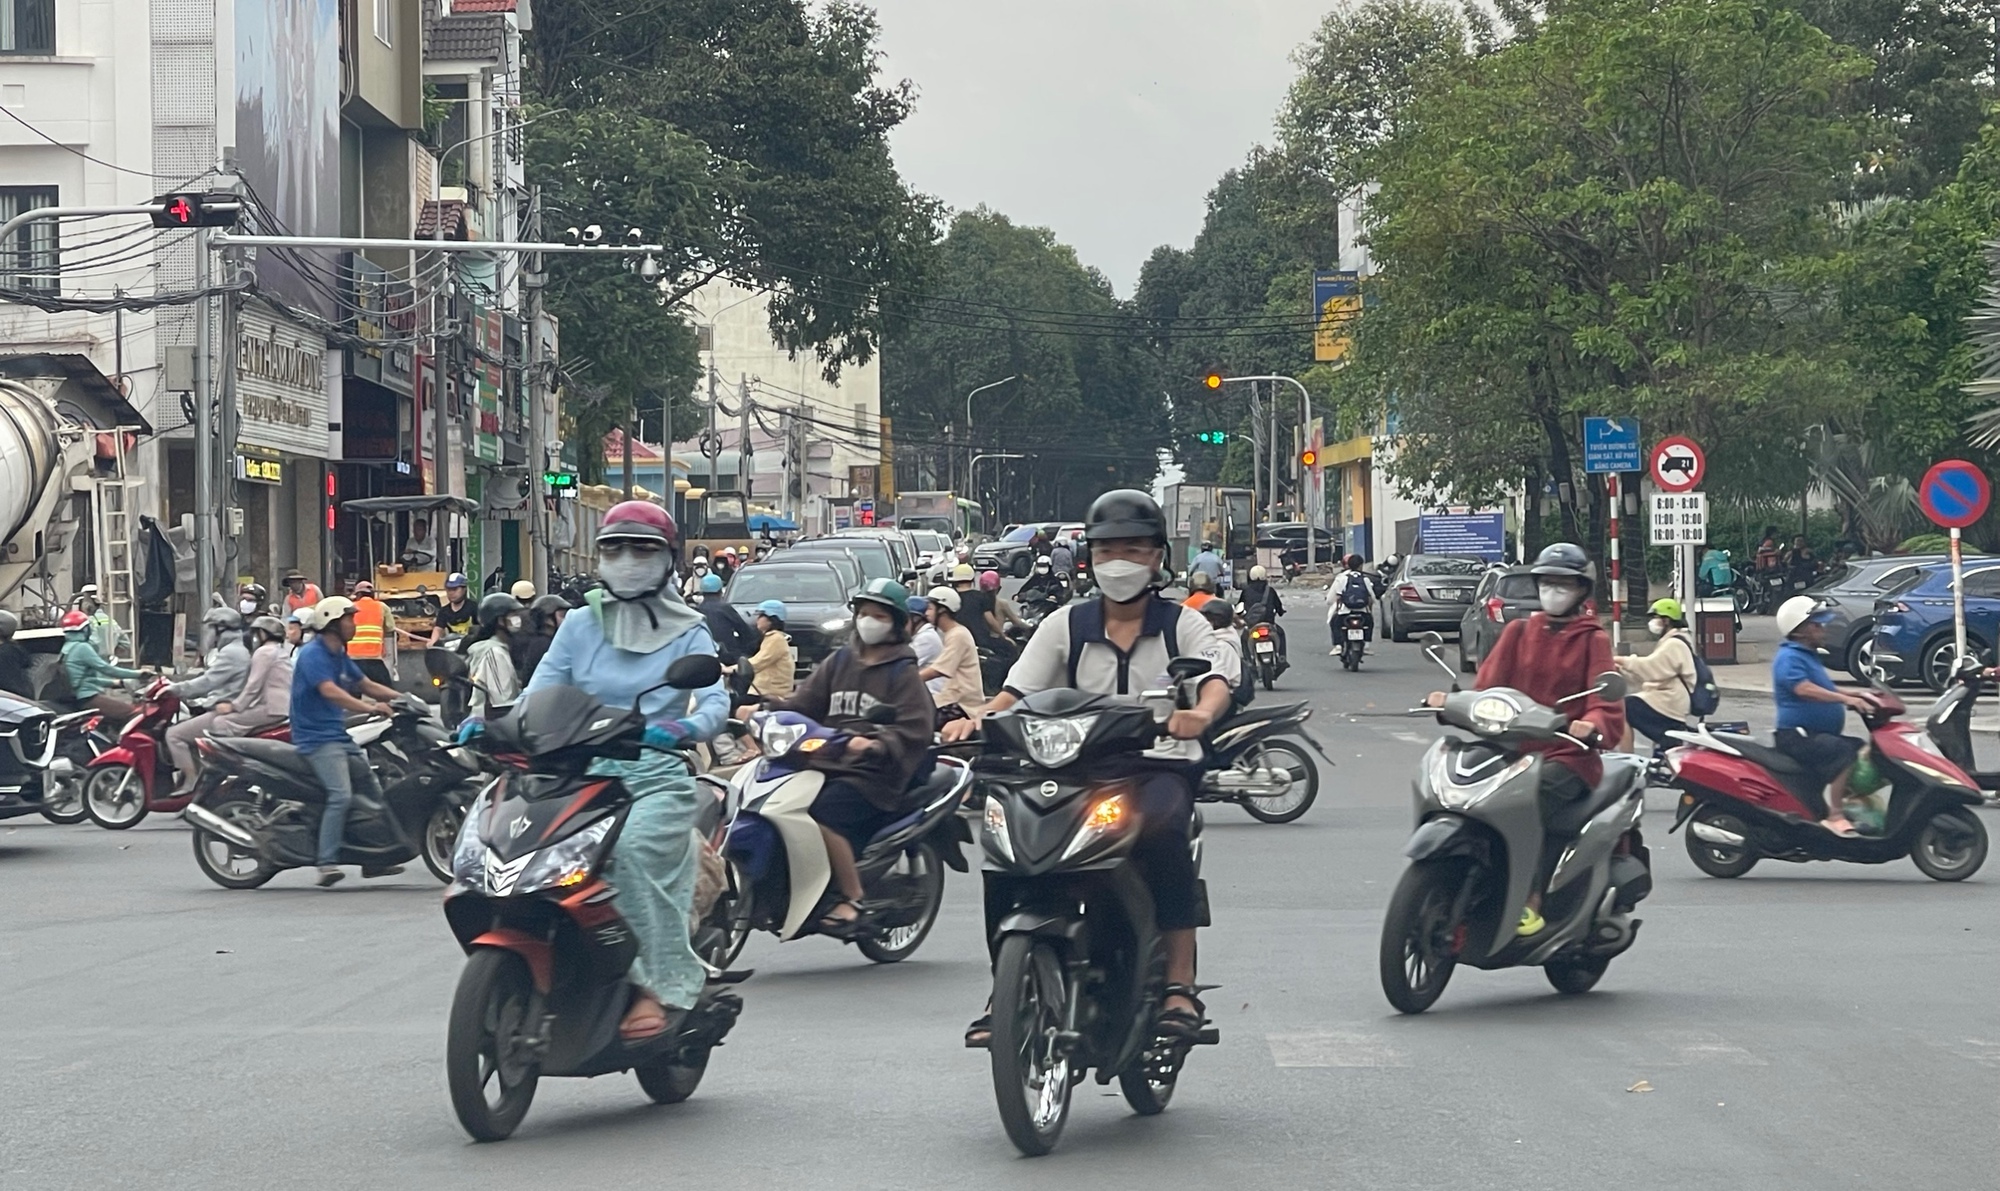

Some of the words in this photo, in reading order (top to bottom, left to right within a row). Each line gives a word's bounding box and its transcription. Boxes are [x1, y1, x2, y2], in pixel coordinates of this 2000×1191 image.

[1657, 497, 1674, 509] 6:00
[1681, 497, 1699, 509] 8:00
[1654, 513, 1673, 525] 11:00
[1681, 513, 1702, 525] 13:00
[1654, 528, 1674, 540] 16:00
